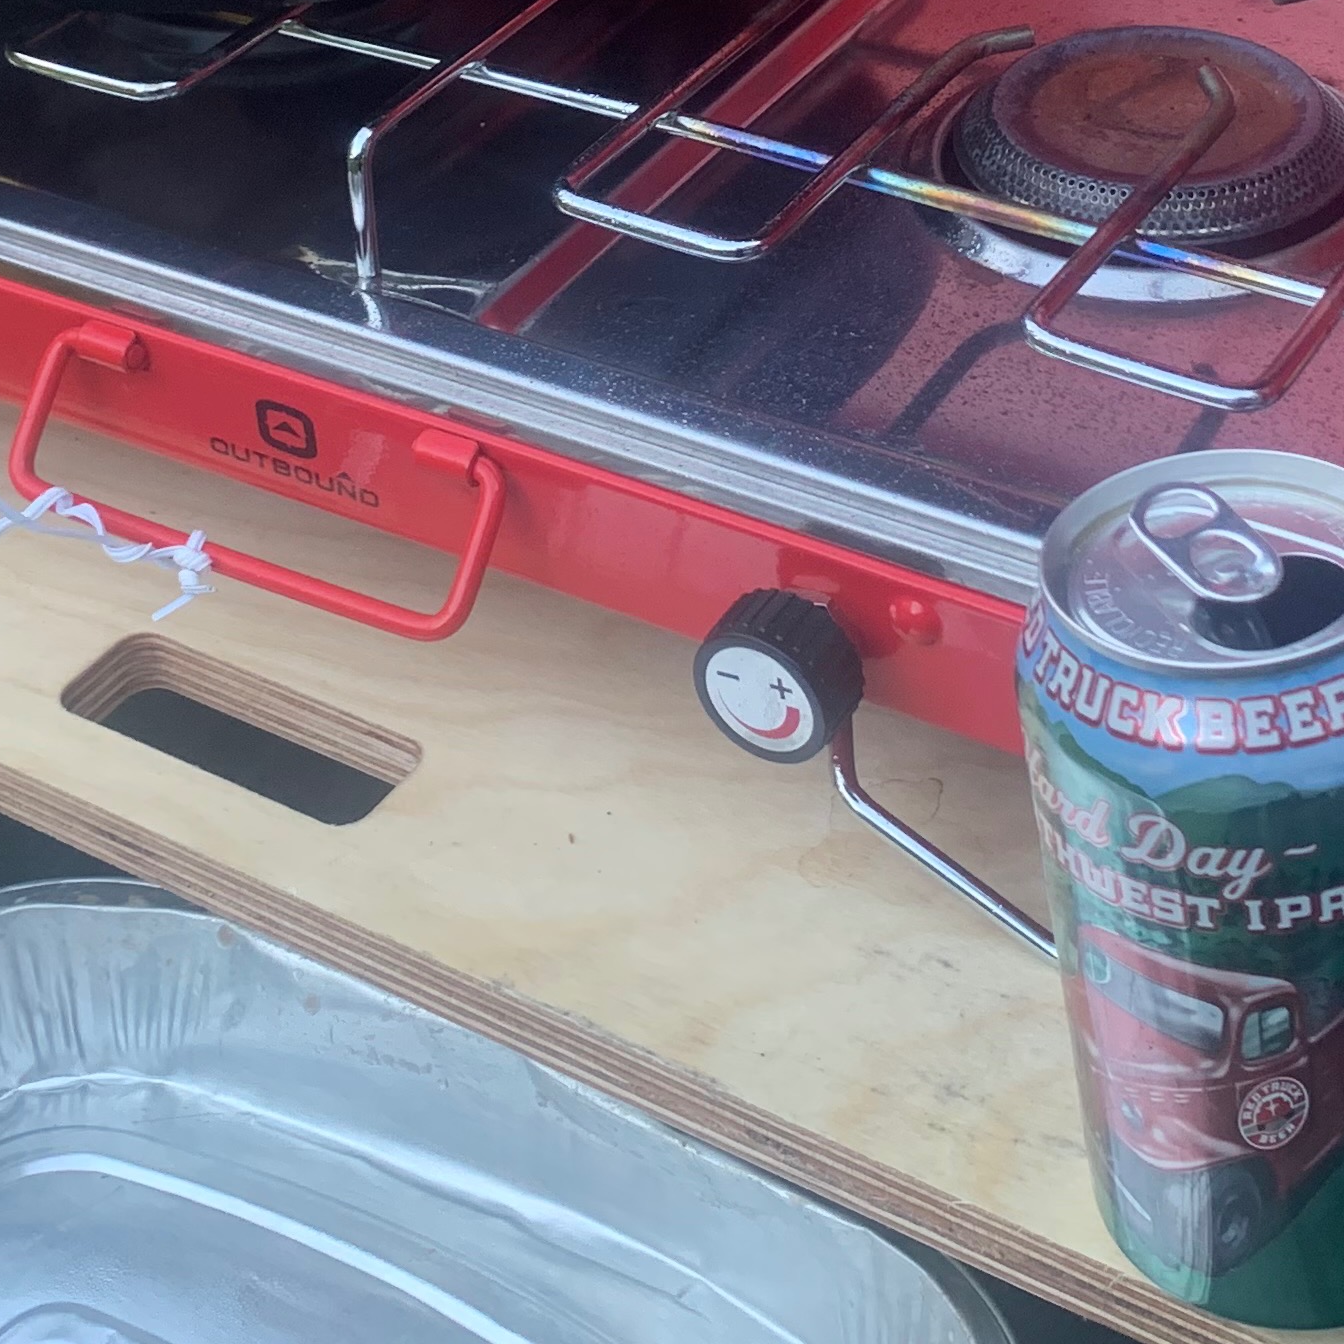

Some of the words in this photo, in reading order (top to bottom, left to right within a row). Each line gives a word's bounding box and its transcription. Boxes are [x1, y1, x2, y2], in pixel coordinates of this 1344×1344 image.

[210, 436, 379, 507] OUTBOUND
[1034, 628, 1188, 751] TRUCK
[1038, 812, 1220, 932] THWEST
[1120, 813, 1273, 900] Day
[1242, 1093, 1262, 1119] RED
[1261, 1081, 1303, 1101] TRUCK
[1259, 1123, 1295, 1144] BEER
